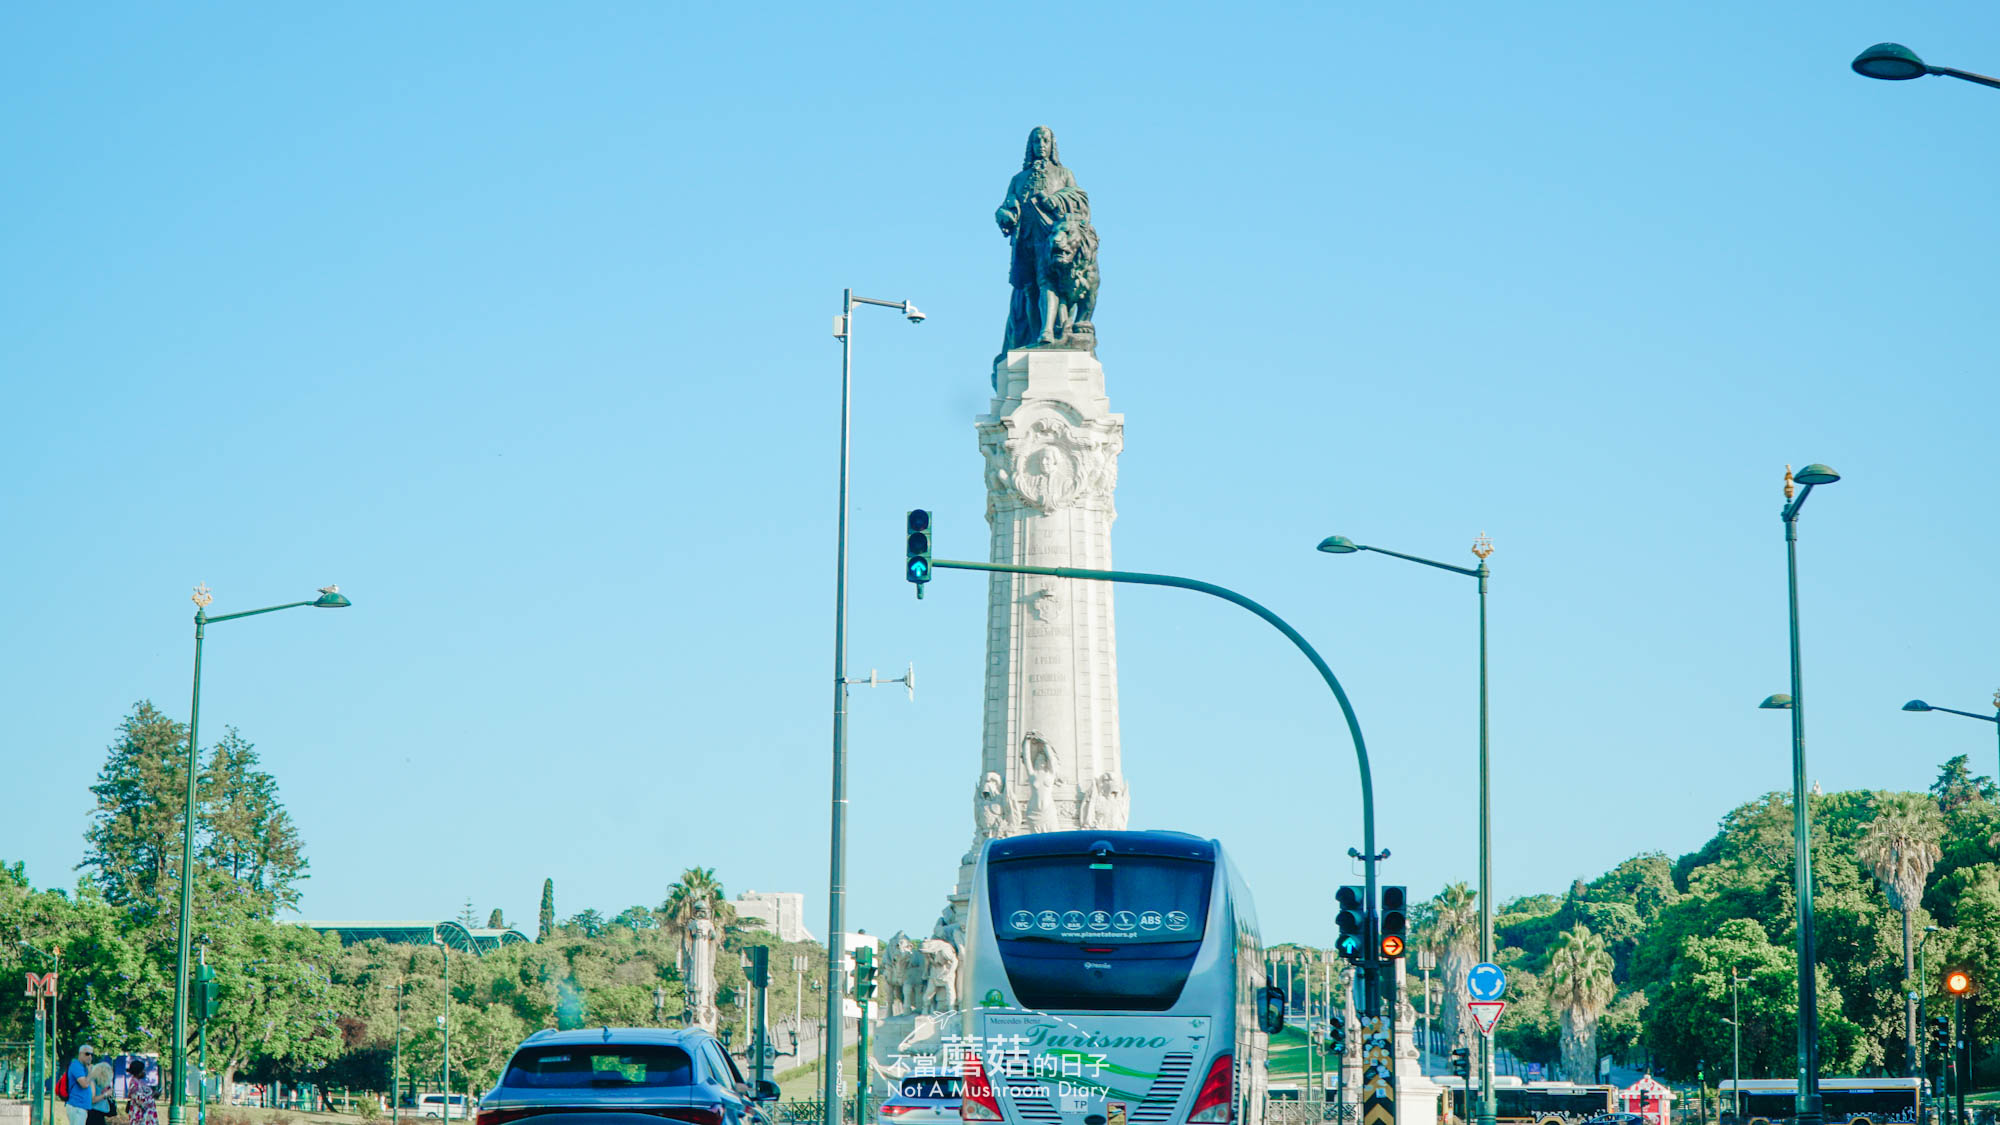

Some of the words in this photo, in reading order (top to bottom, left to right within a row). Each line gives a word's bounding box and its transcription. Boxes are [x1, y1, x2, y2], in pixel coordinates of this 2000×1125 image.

[1140, 916, 1161, 925] ABS
[1061, 931, 1137, 939] www.planetatours.pt
[24, 972, 58, 997] M
[990, 1017, 1022, 1025] Mercedes
[1023, 1017, 1041, 1025] Benz
[1019, 1023, 1173, 1048] Turismo
[1073, 1100, 1088, 1109] TP
